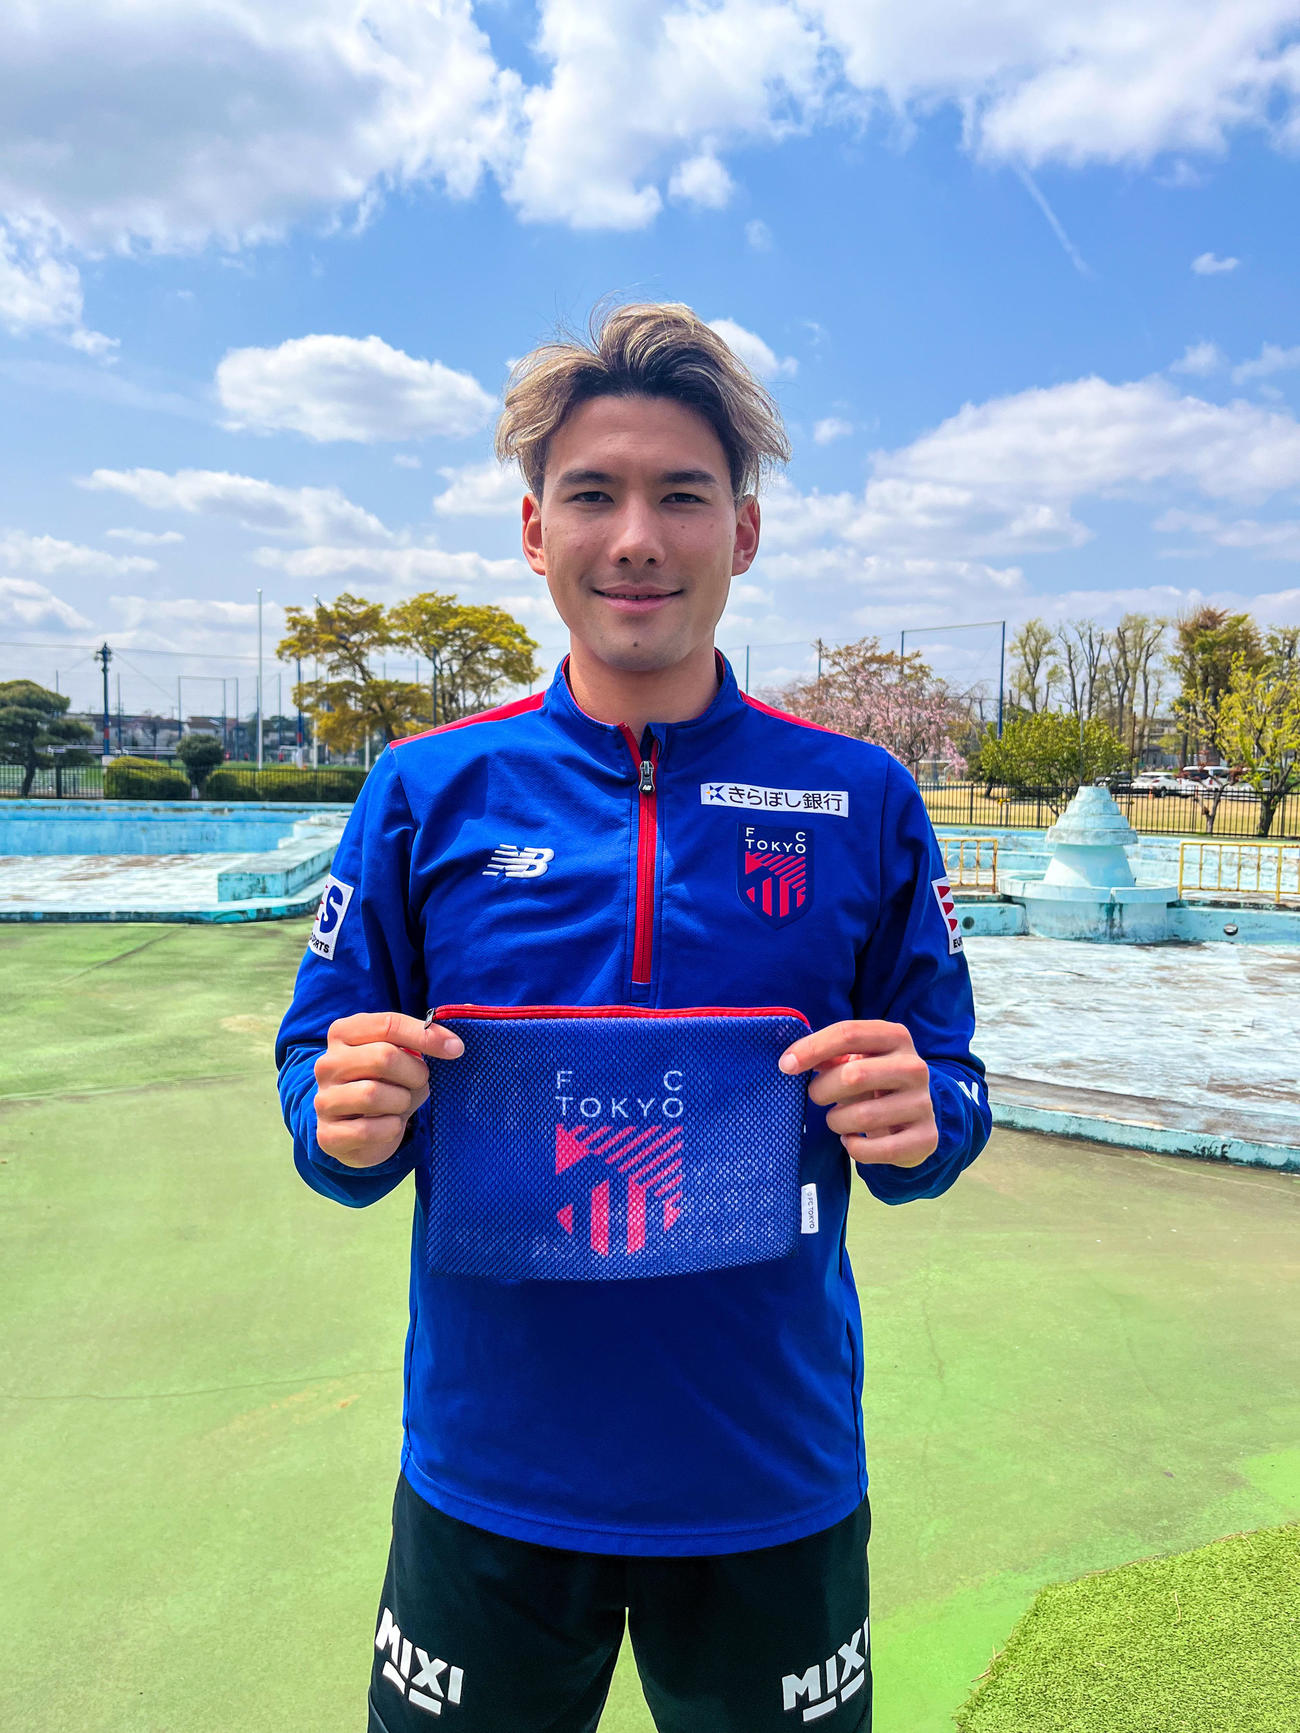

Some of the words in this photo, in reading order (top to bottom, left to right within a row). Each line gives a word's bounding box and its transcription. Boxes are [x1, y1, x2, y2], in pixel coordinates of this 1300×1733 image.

[728, 786, 843, 811] きらぼし銀行
[745, 827, 755, 837] F
[795, 831, 806, 842] C
[744, 839, 807, 853] TOKYO
[556, 1070, 572, 1089] F
[663, 1070, 683, 1092] C
[555, 1096, 684, 1118] TOKYO
[375, 1607, 464, 1705] MIXI
